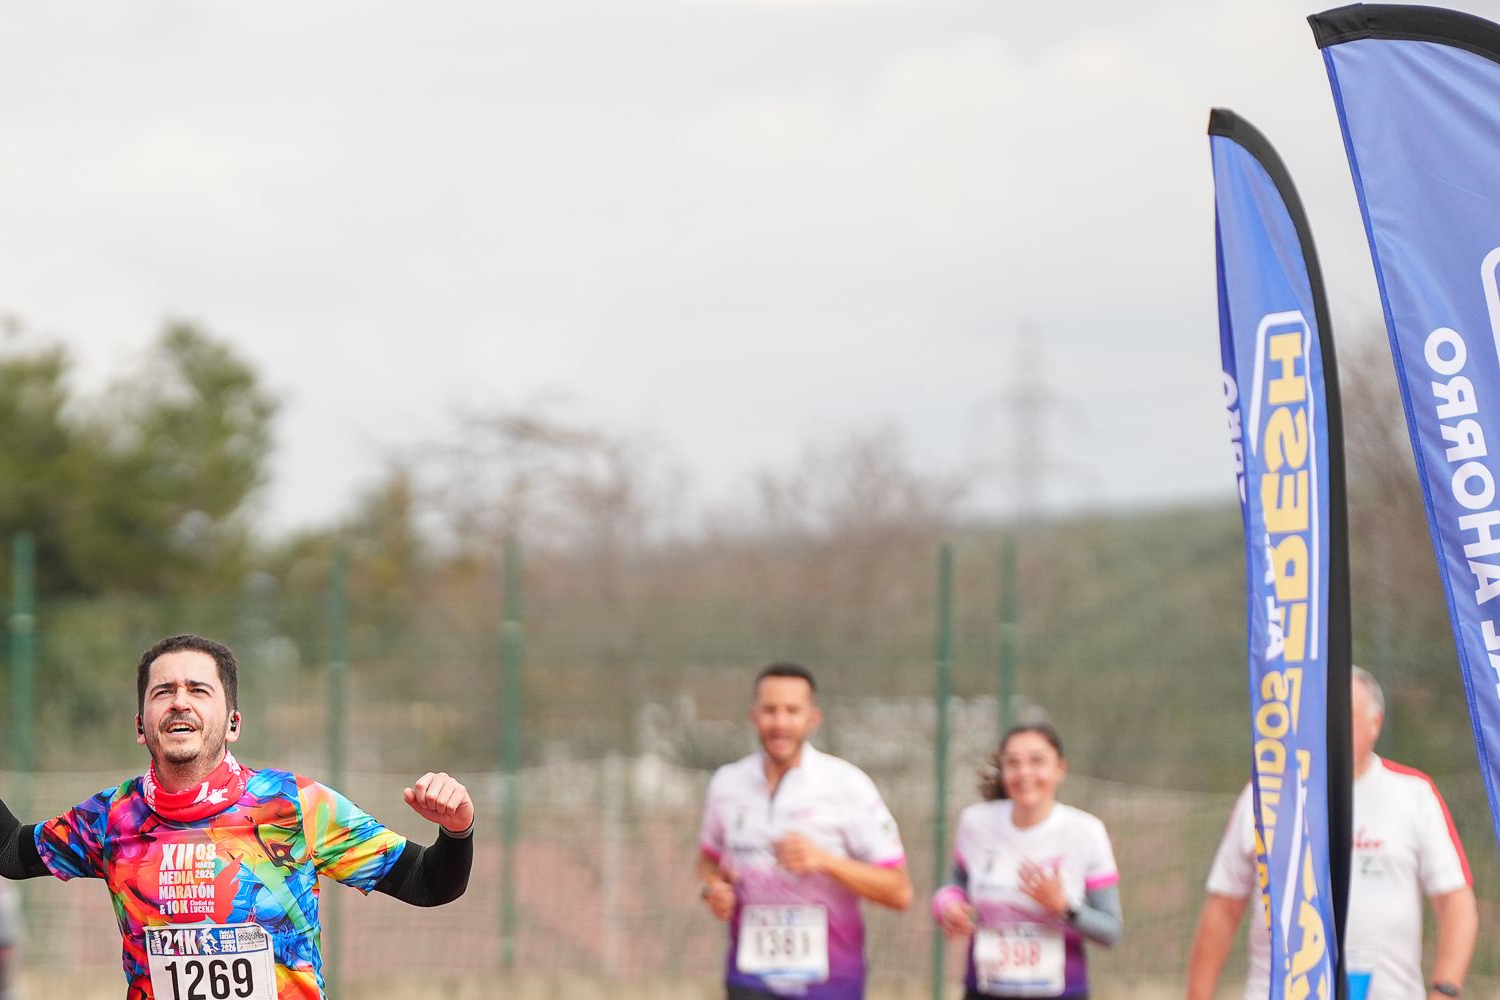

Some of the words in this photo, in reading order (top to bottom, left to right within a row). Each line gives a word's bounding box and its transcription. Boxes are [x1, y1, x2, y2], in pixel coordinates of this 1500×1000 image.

[160, 844, 194, 870] XII
[195, 844, 216, 860] 08
[159, 871, 195, 885] MEDIA
[159, 882, 214, 899] MARATÓN
[166, 900, 188, 914] 10K
[161, 930, 199, 955] 21K
[165, 958, 254, 1000] 1269
